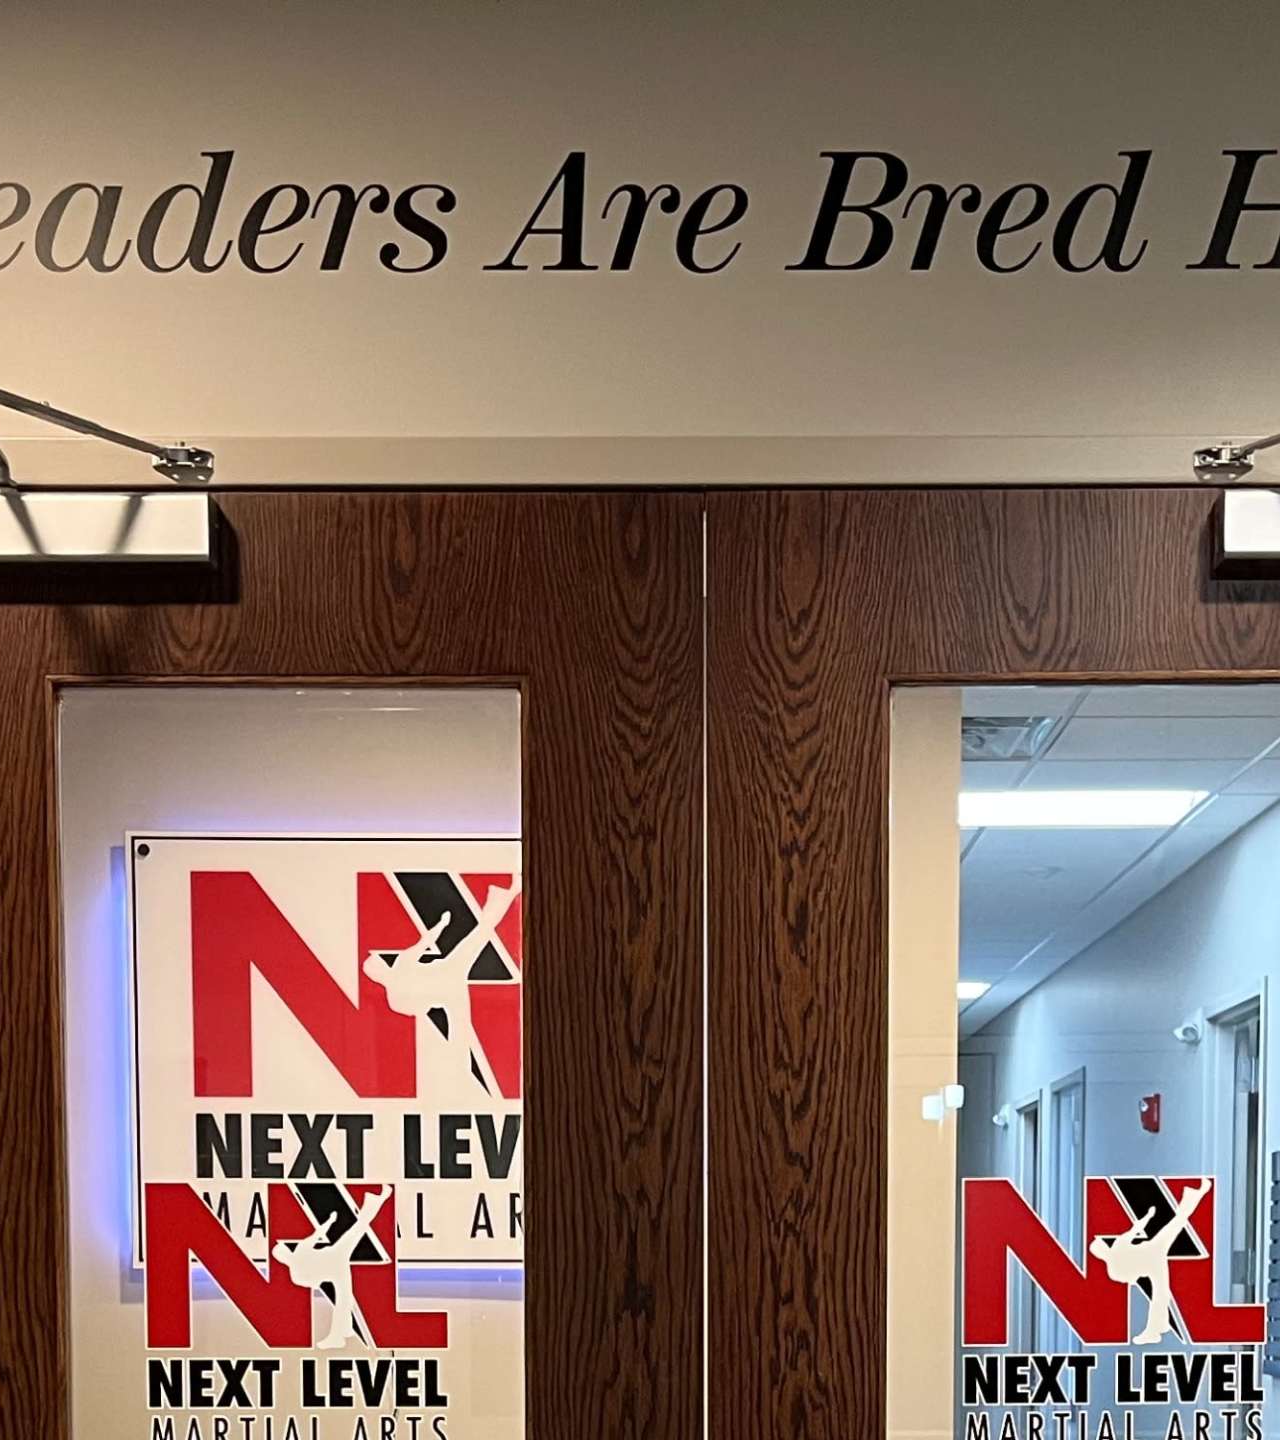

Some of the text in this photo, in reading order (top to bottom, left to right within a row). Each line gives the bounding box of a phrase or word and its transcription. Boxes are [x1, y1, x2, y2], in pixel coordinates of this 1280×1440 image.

[482, 150, 750, 274] Are
[784, 149, 1154, 274] Bred
[195, 1113, 521, 1179] NEXT LEV
[470, 1192, 523, 1239] AR
[147, 1357, 449, 1408] NEXT LEVEL
[963, 1353, 1265, 1405] NEXT LEVEL
